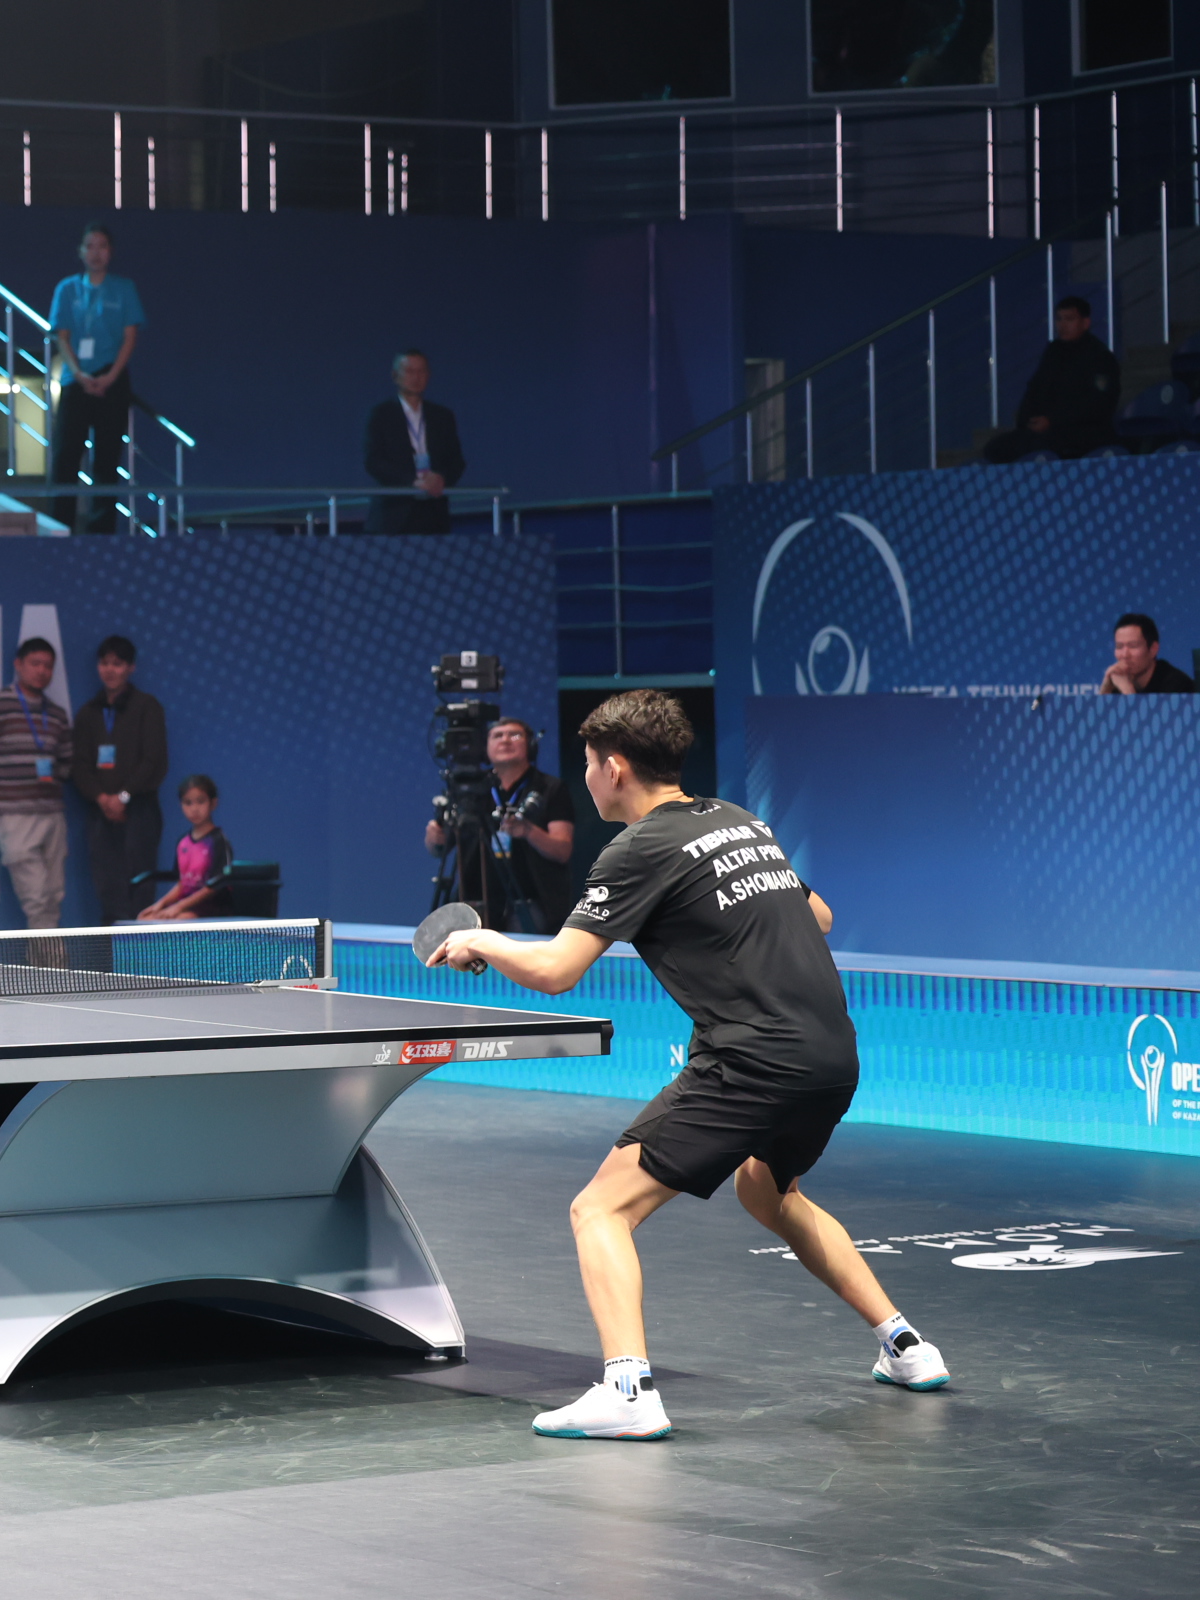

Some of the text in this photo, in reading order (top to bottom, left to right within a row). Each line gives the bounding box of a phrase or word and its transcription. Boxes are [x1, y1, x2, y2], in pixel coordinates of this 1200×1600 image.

[681, 825, 757, 859] TIBHAR
[712, 844, 786, 878] ALTAY PRO
[402, 1041, 513, 1064] 红双喜 DHS
[1172, 1099, 1183, 1108] OF
[1183, 1100, 1197, 1110] THE
[1172, 1111, 1182, 1119] OF
